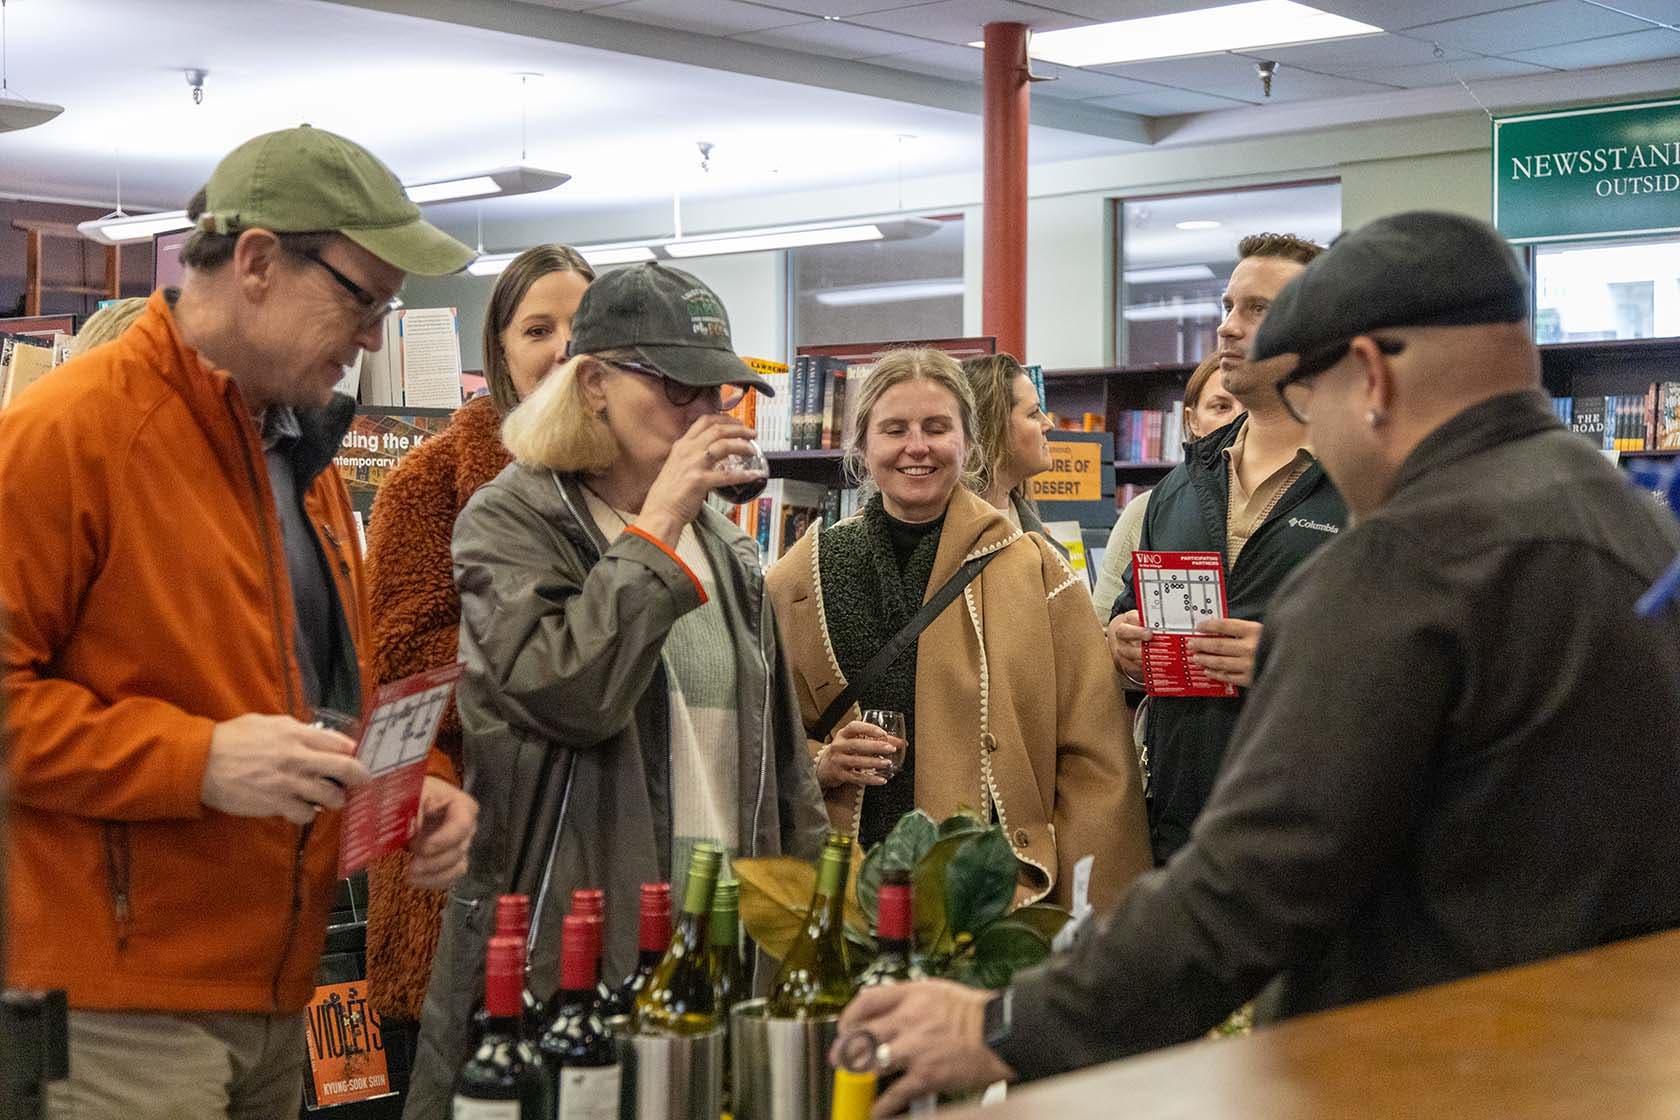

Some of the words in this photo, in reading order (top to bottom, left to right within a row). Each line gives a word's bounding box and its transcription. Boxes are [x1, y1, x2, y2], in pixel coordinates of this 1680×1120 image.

[1577, 413, 1600, 424] THE
[1572, 422, 1604, 433] ROAD
[339, 430, 378, 452] ding
[382, 432, 409, 449] the
[1075, 459, 1091, 473] OF
[1033, 481, 1080, 495] DESERT
[1298, 518, 1338, 534] Columbia
[1135, 553, 1162, 564] VINO
[306, 1000, 383, 1060] VIOLETS
[323, 1077, 368, 1096] KYUNG-SOOK
[368, 1074, 385, 1088] SHIN
